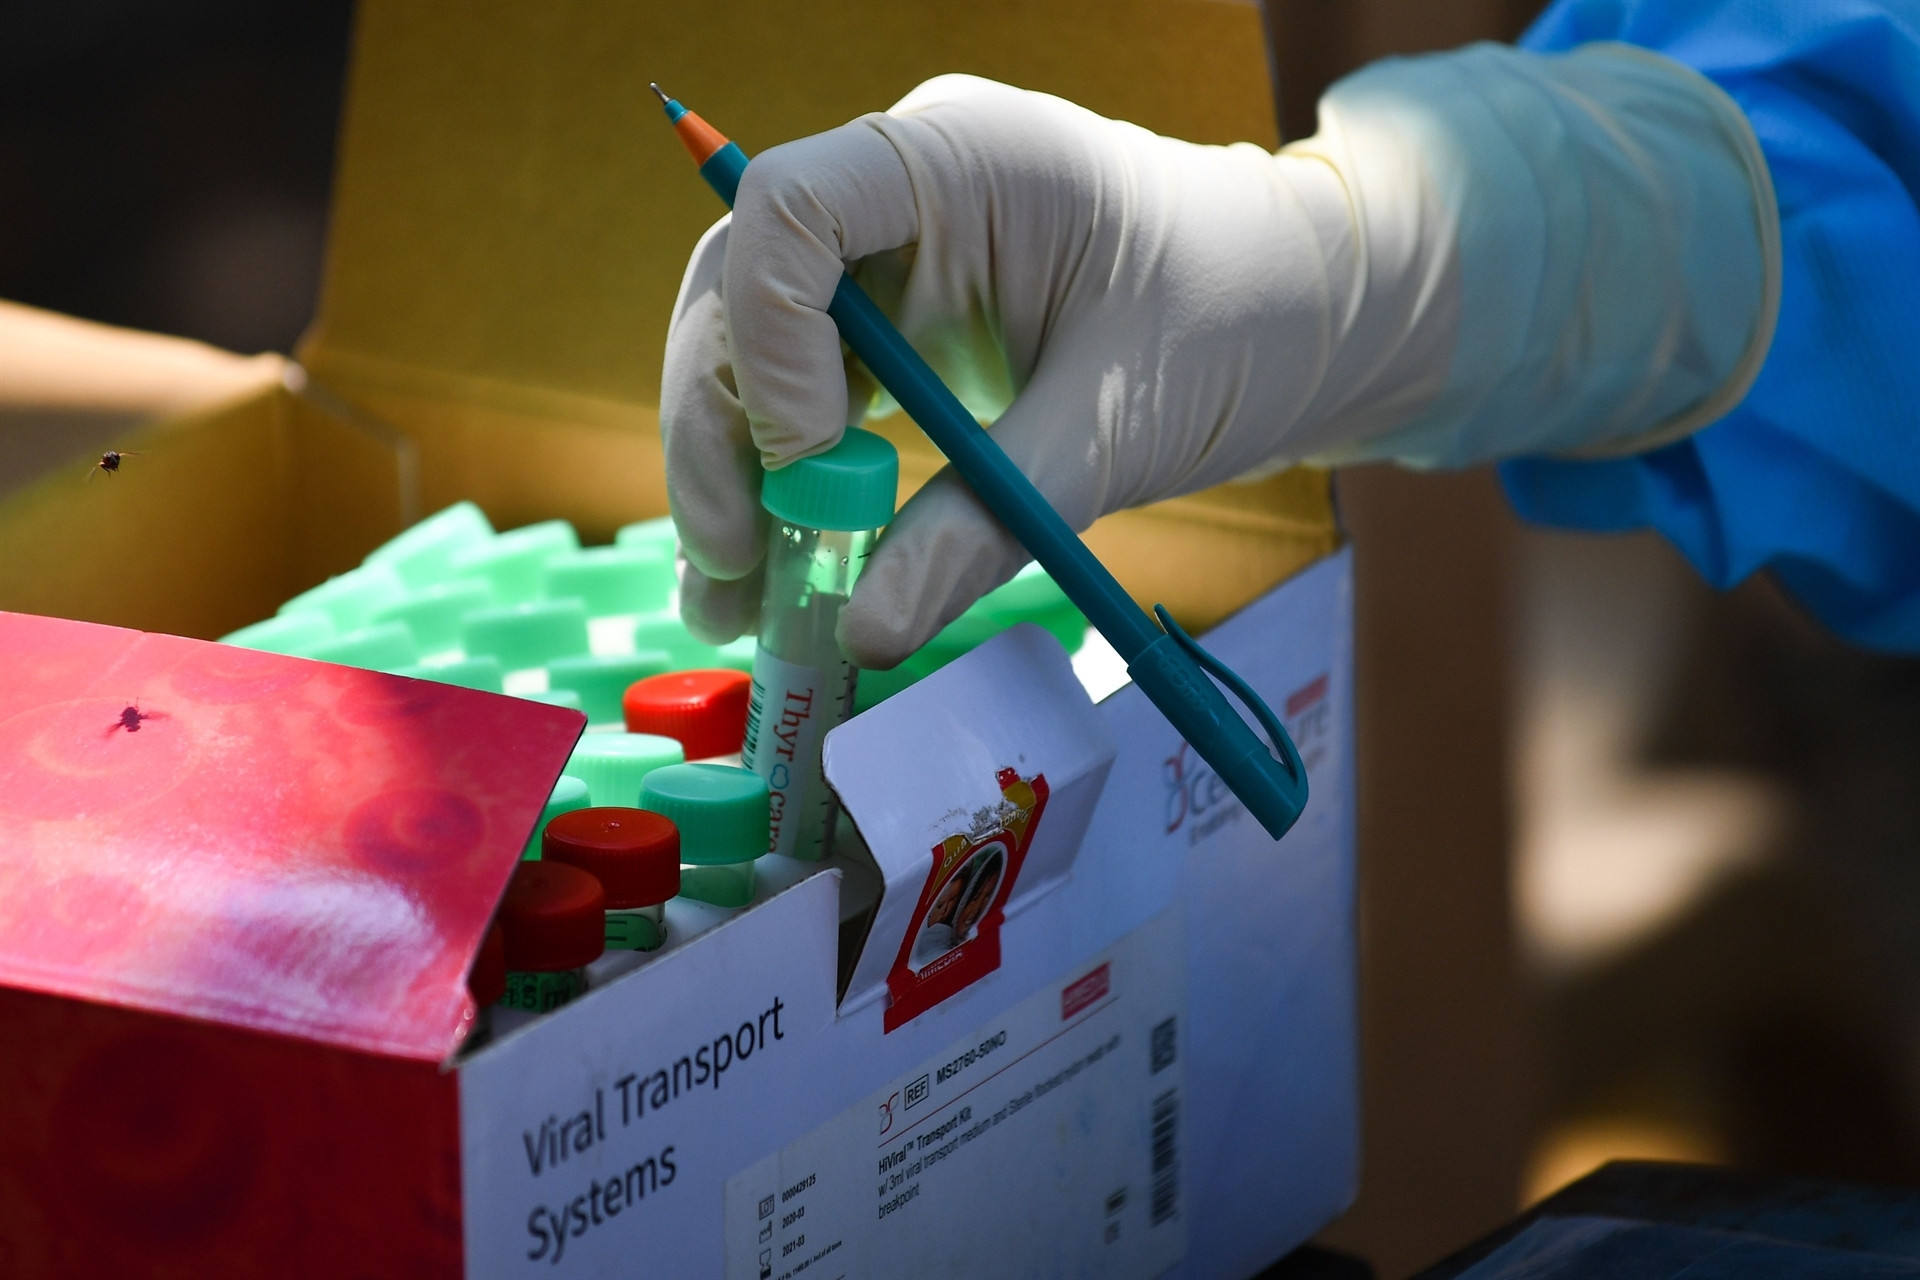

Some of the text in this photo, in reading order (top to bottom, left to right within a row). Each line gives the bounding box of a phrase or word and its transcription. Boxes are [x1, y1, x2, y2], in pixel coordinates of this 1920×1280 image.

[523, 996, 785, 1177] Viral Transport
[907, 1080, 927, 1107] REF
[917, 1114, 958, 1151] Transport
[959, 1105, 972, 1126] Kit
[906, 1157, 922, 1180] viral
[526, 1146, 677, 1266] Systems
[879, 1182, 920, 1220] breakpoint
[782, 1234, 805, 1258] 2021-03
